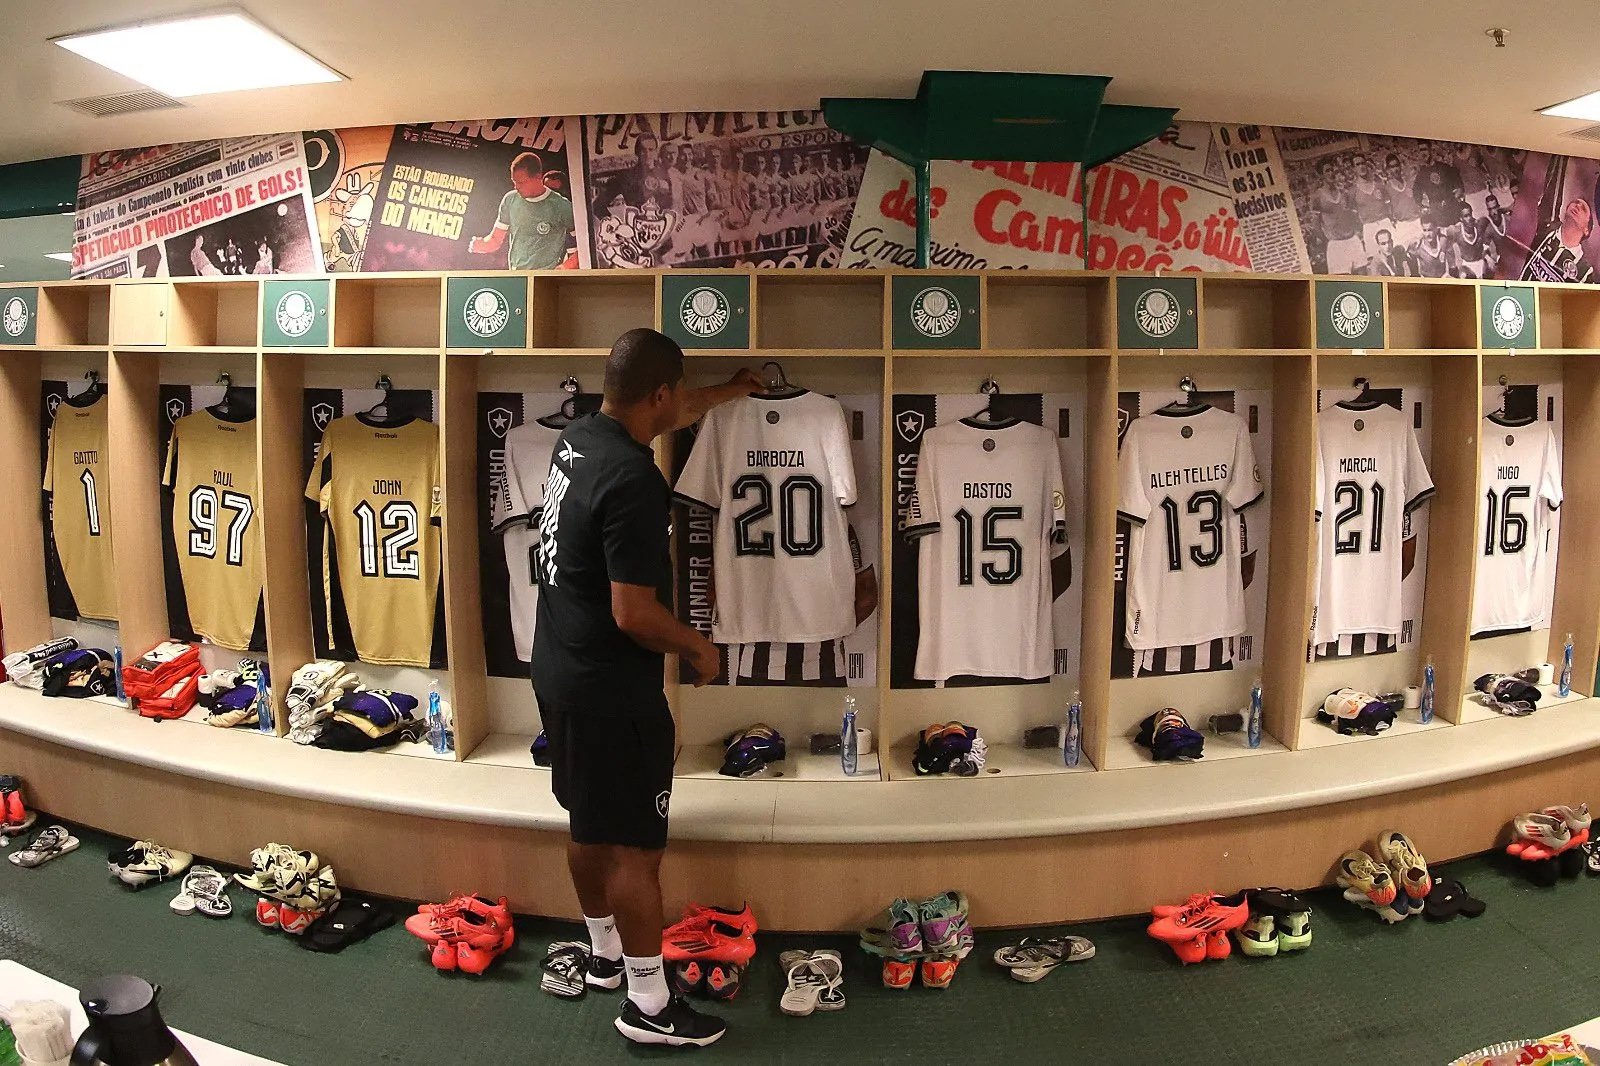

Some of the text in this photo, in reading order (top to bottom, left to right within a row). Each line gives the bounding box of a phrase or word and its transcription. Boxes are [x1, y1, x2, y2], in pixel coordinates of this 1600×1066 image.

[1225, 147, 1268, 169] foram
[117, 203, 126, 217] do
[128, 187, 172, 215] Campeonato
[174, 175, 204, 196] Paulista
[207, 168, 223, 184] com
[226, 159, 246, 177] vinte
[248, 150, 274, 169] clubes
[393, 164, 475, 193] ESTÃO ROUBANDO
[1233, 166, 1275, 194] os 3 a 1
[387, 181, 470, 214] OS CANECOS
[1234, 192, 1288, 219] decisivos
[72, 167, 304, 267] SPETACULO PIROTECNICO DE GOLS!
[380, 201, 464, 241] DO MENGO
[467, 309, 506, 334] PALMEIRAS
[683, 308, 727, 334] PALMEIRAS
[914, 309, 958, 334] PALMEIRAS
[1138, 310, 1178, 334] PALMEIRAS
[1334, 312, 1368, 335] PALMEIRAS
[74, 450, 98, 465] GATITO
[747, 450, 805, 468] BARBOZA
[1339, 458, 1378, 474] MARÇAL
[1183, 464, 1227, 483] TELLES
[1497, 465, 1520, 480] HUGO
[372, 480, 402, 496] JOHN
[963, 482, 1012, 499] BASTOS
[79, 467, 101, 537] 1
[731, 472, 825, 559] 20
[188, 484, 254, 567] 97
[1160, 489, 1223, 572] 13
[1334, 478, 1385, 556] 21
[1484, 485, 1531, 556] 16
[353, 499, 419, 580] 12
[952, 505, 1023, 587] 15
